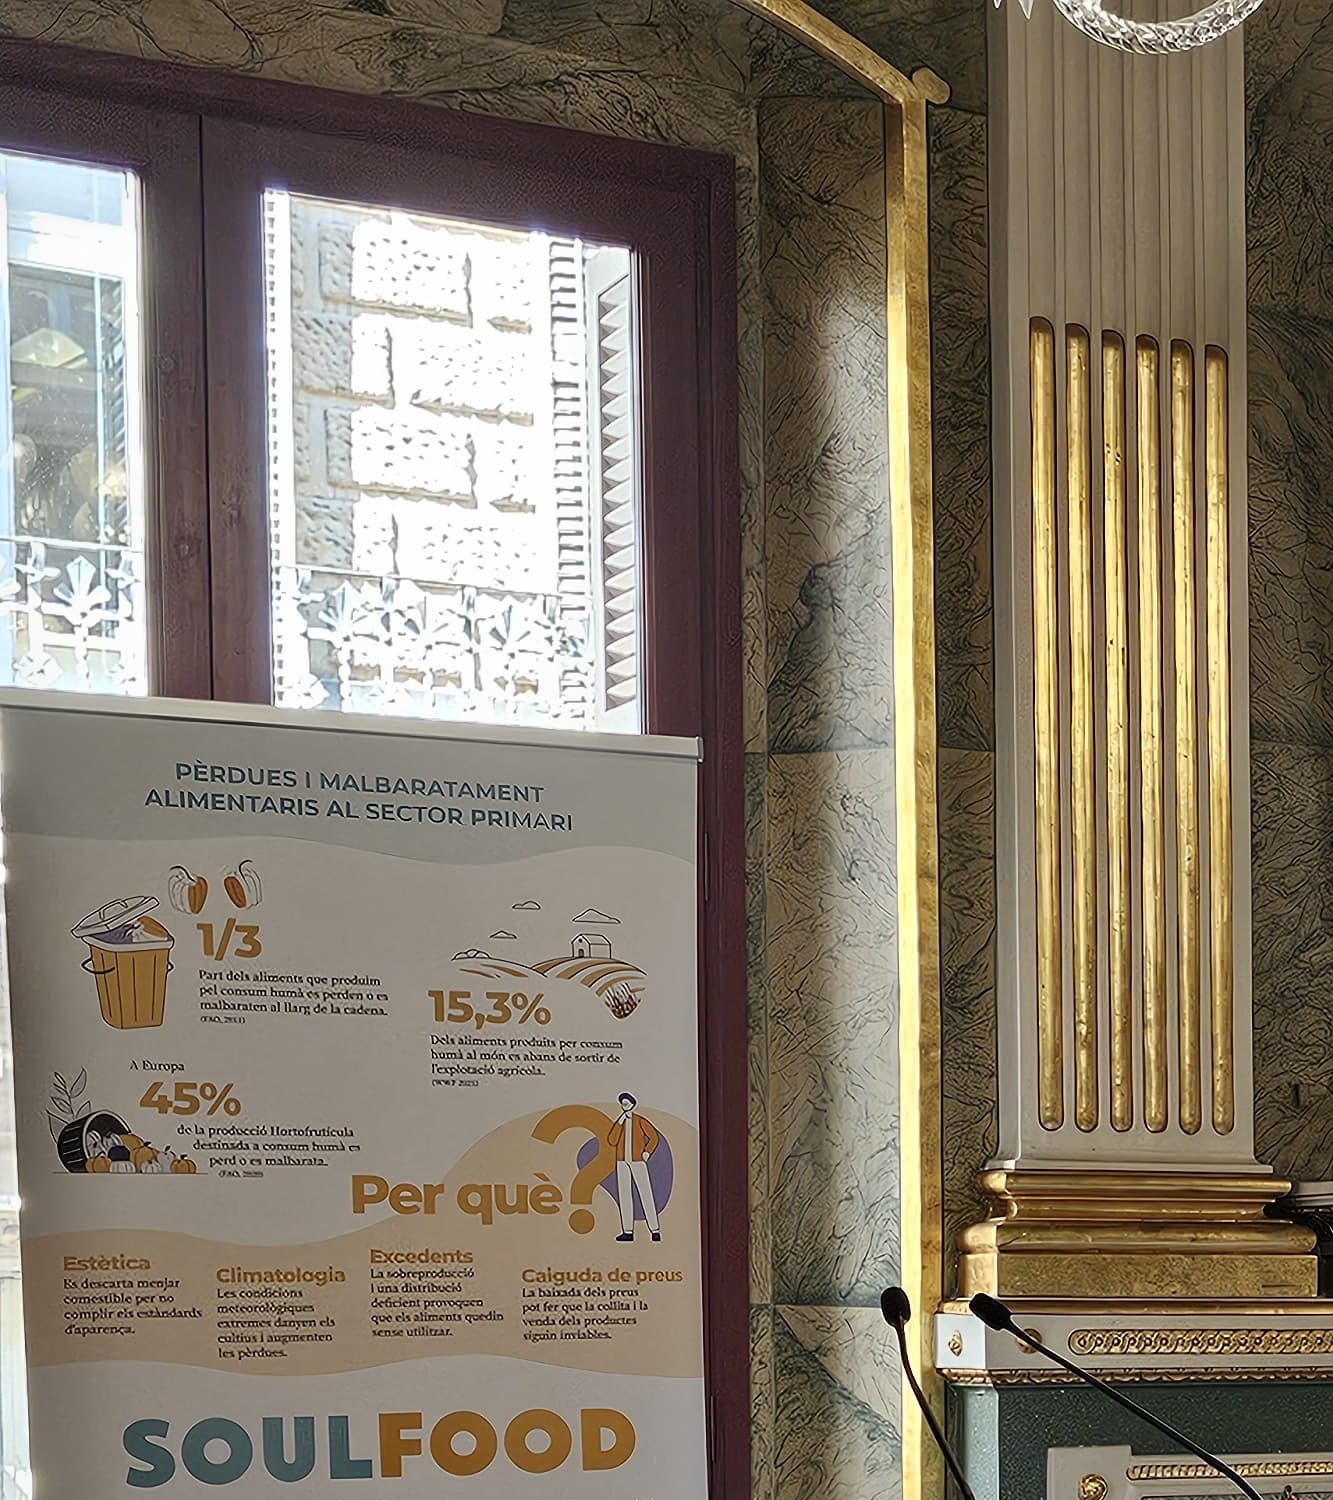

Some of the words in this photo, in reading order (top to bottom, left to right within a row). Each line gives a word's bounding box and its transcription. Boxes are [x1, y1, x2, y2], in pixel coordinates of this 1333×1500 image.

[175, 760, 297, 788] PÈRDUES
[305, 772, 311, 789] I
[320, 774, 544, 802] MALBARATAMENT
[145, 789, 318, 817] ALIMENTARIS
[326, 802, 359, 819] AL
[366, 803, 464, 824] SECTOR
[472, 810, 572, 831] PRIMARI
[197, 918, 262, 960] 1/3
[428, 990, 551, 1029] 15,3%
[139, 1081, 242, 1116] 45%
[352, 1174, 445, 1214] Per
[64, 1254, 151, 1271] Estètica
[217, 1266, 345, 1286] Climatologia
[370, 1249, 474, 1264] Excedents
[522, 1267, 601, 1285] Caiguda
[608, 1268, 631, 1282] de
[636, 1271, 682, 1285] preus
[123, 1408, 636, 1488] SOULFOOD
